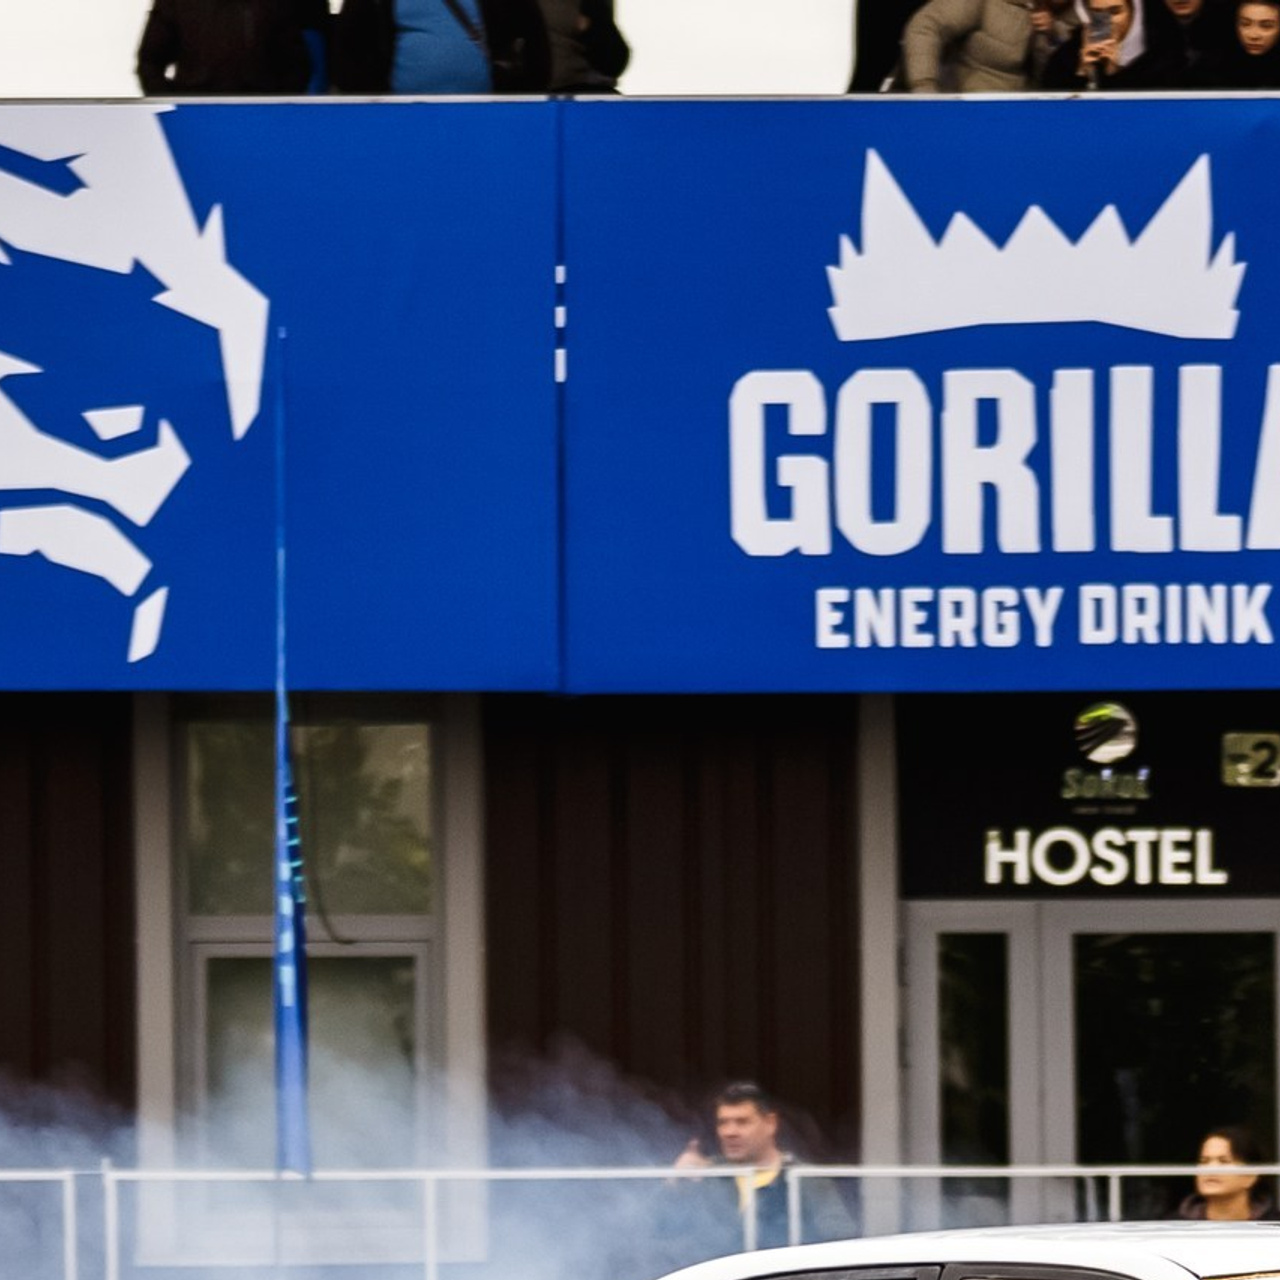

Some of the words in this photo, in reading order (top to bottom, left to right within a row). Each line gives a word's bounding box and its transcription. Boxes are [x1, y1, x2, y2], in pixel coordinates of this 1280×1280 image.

[815, 586, 1064, 648] ENERGY
[1079, 583, 1274, 645] DRINK
[984, 827, 1229, 886] HOSTEL
